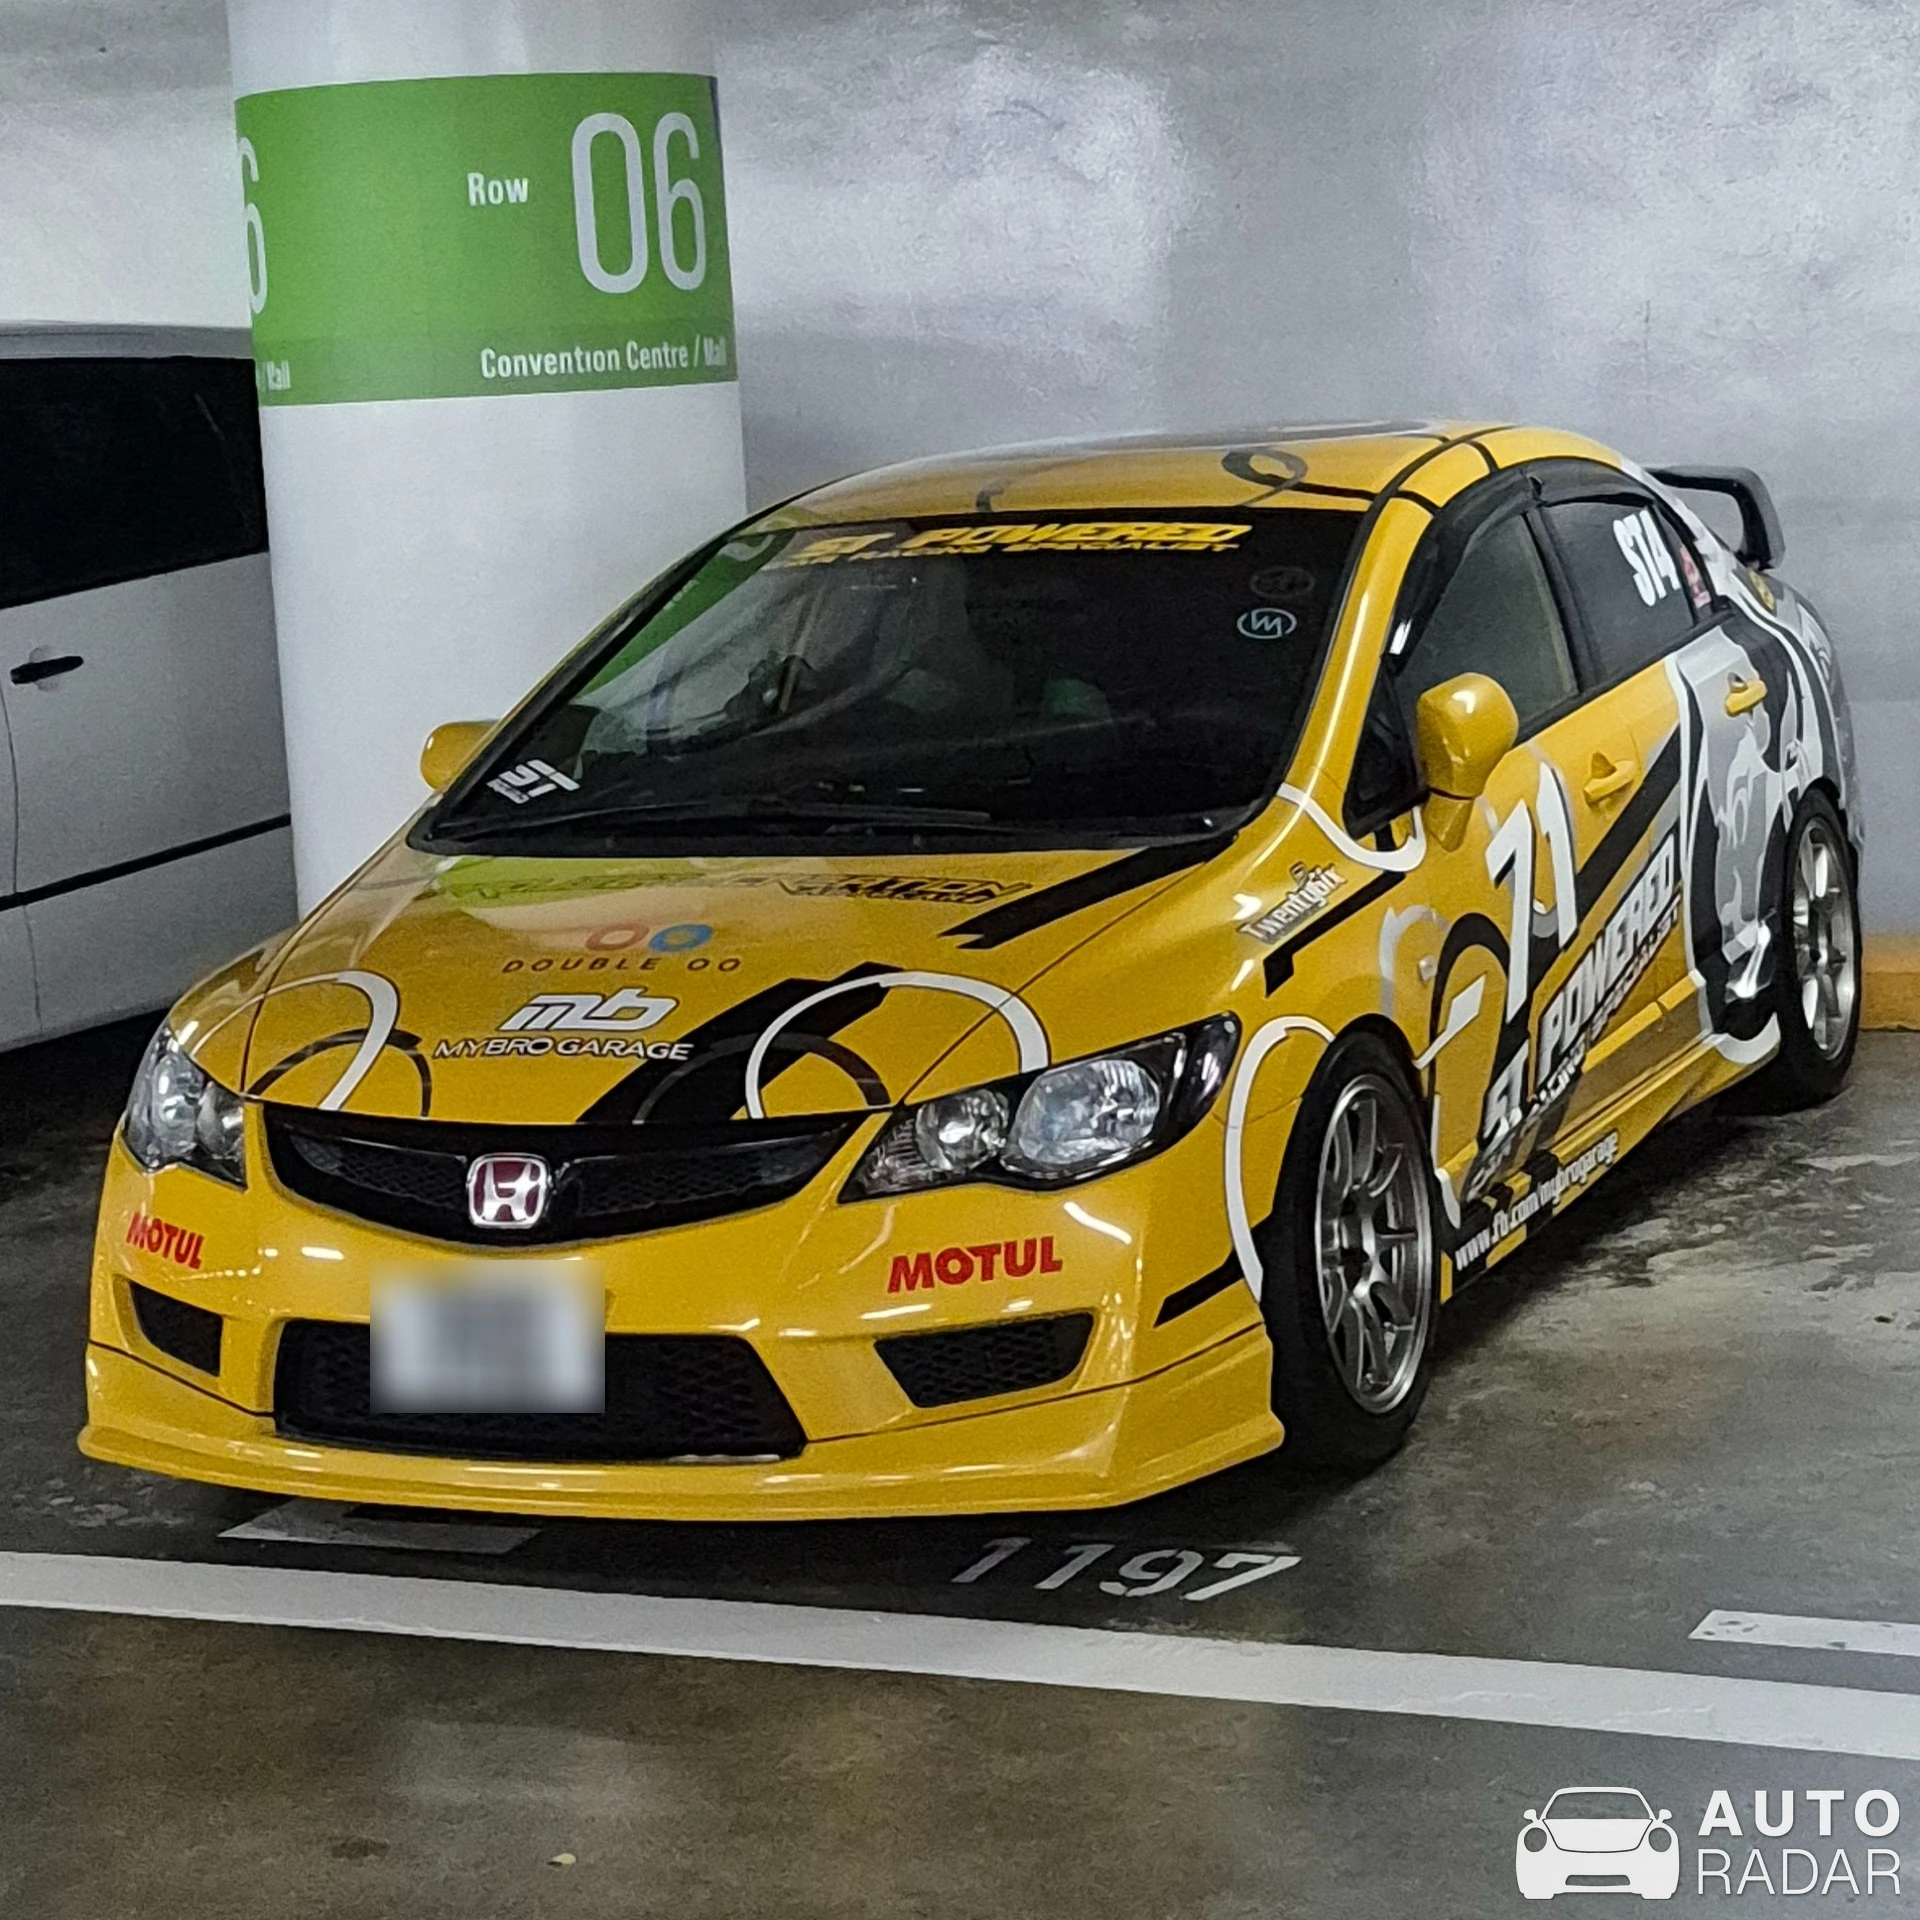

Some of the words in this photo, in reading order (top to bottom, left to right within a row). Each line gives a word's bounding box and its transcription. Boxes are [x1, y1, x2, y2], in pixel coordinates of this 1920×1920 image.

[467, 172, 529, 206] Row
[571, 112, 706, 294] 06
[480, 345, 620, 379] Convention
[626, 340, 689, 370] Centre
[897, 521, 1253, 550] POWERED
[501, 957, 662, 973] DOUBLE
[1537, 833, 1676, 1089] POWERED
[126, 1212, 205, 1270] MOTUL
[888, 1236, 1063, 1294] MOTUL
[950, 1536, 1303, 1601] 1197
